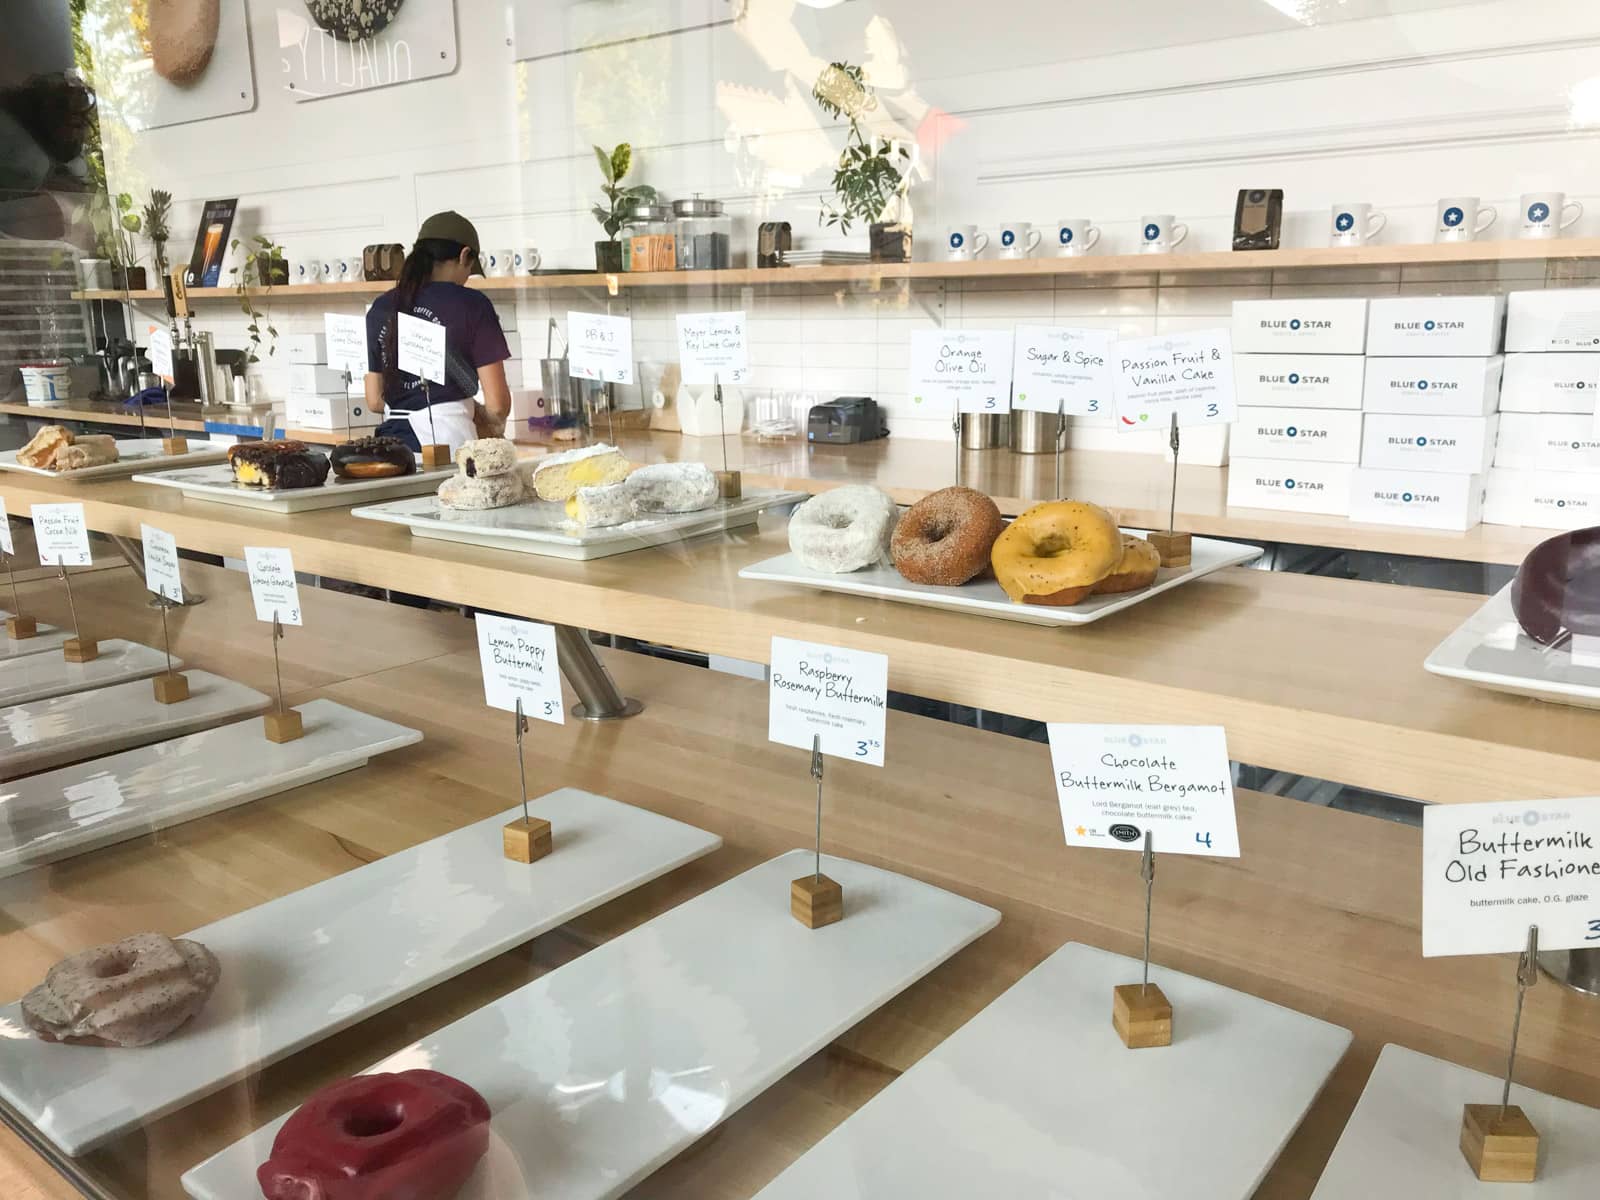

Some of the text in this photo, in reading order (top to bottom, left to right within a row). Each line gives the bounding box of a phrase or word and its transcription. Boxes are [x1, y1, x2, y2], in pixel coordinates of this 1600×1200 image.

[1260, 320, 1332, 329] BLUE STAR
[1394, 321, 1465, 330] BLUE STAR
[940, 343, 983, 360] Orange
[1027, 347, 1105, 368] Sugar & Spice
[934, 359, 987, 373] Olive Oil
[1121, 348, 1222, 374] Passion Fruit &
[1131, 367, 1215, 388] Vanilla Cake
[1259, 374, 1330, 385] BLUE STAR
[1390, 380, 1459, 390] BLUE STAR
[984, 397, 997, 409] 3
[1087, 399, 1099, 412] 3
[1206, 403, 1220, 418] 3
[1257, 427, 1328, 439] BLUE STAR
[1388, 437, 1457, 447] BLUE STAR
[1548, 440, 1569, 448] BLUE
[1255, 478, 1325, 491] BLUE STAR
[1374, 491, 1441, 503] BLUE STAR
[1534, 498, 1588, 507] BLUE STAR
[487, 632, 546, 661] Lemon Poppy
[493, 648, 544, 674] Buttermilk
[799, 660, 853, 690] Raspberry
[773, 673, 884, 708] Rosemary Buttermilk
[1100, 753, 1177, 771] Chocolate
[1060, 771, 1227, 798] Buttermilk Bergamot
[1092, 800, 1108, 809] Lord
[1109, 801, 1143, 811] Bergamot
[1101, 810, 1193, 821] chocolate buttermilk cake
[1195, 831, 1212, 849] 4
[1459, 828, 1594, 855] Buttermilk
[1445, 858, 1600, 882] Old Fashione
[1470, 893, 1589, 908] buttermilk cake, O.G. glaze
